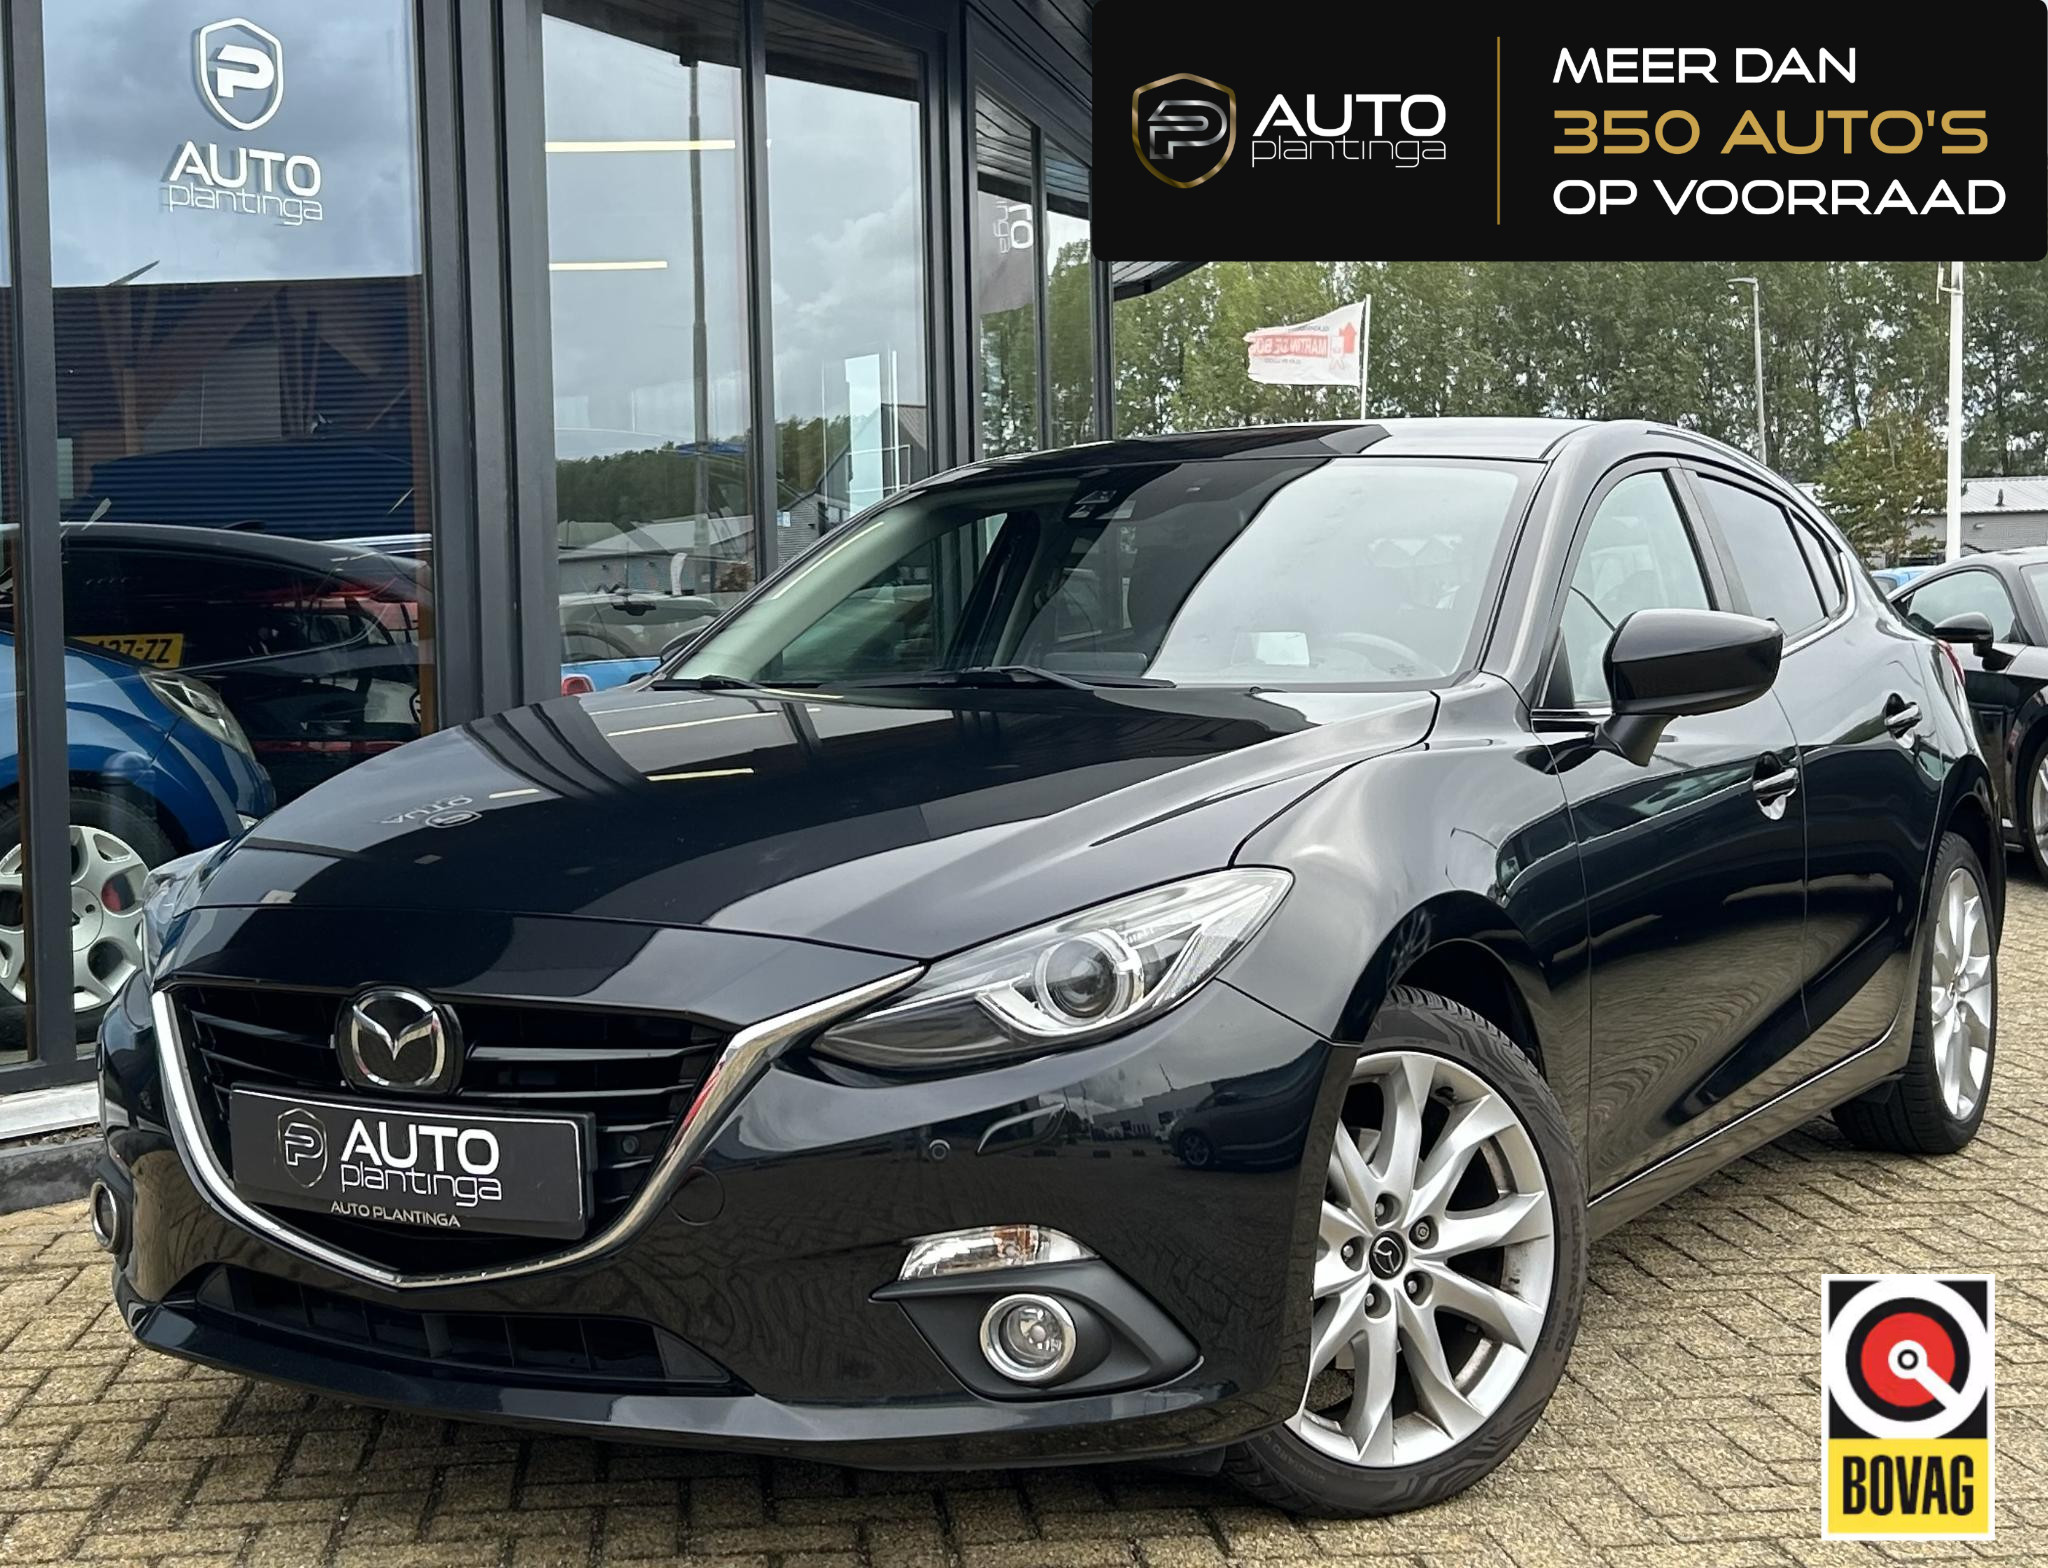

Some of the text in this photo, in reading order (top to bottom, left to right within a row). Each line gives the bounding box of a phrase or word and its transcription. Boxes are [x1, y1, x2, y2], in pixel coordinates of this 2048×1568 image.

[169, 140, 321, 197] AUTO
[168, 182, 323, 226] plantinga
[340, 1118, 500, 1176] AUTO
[340, 1160, 502, 1208] plantinga
[330, 1200, 461, 1228] AUTO PLANTINGA
